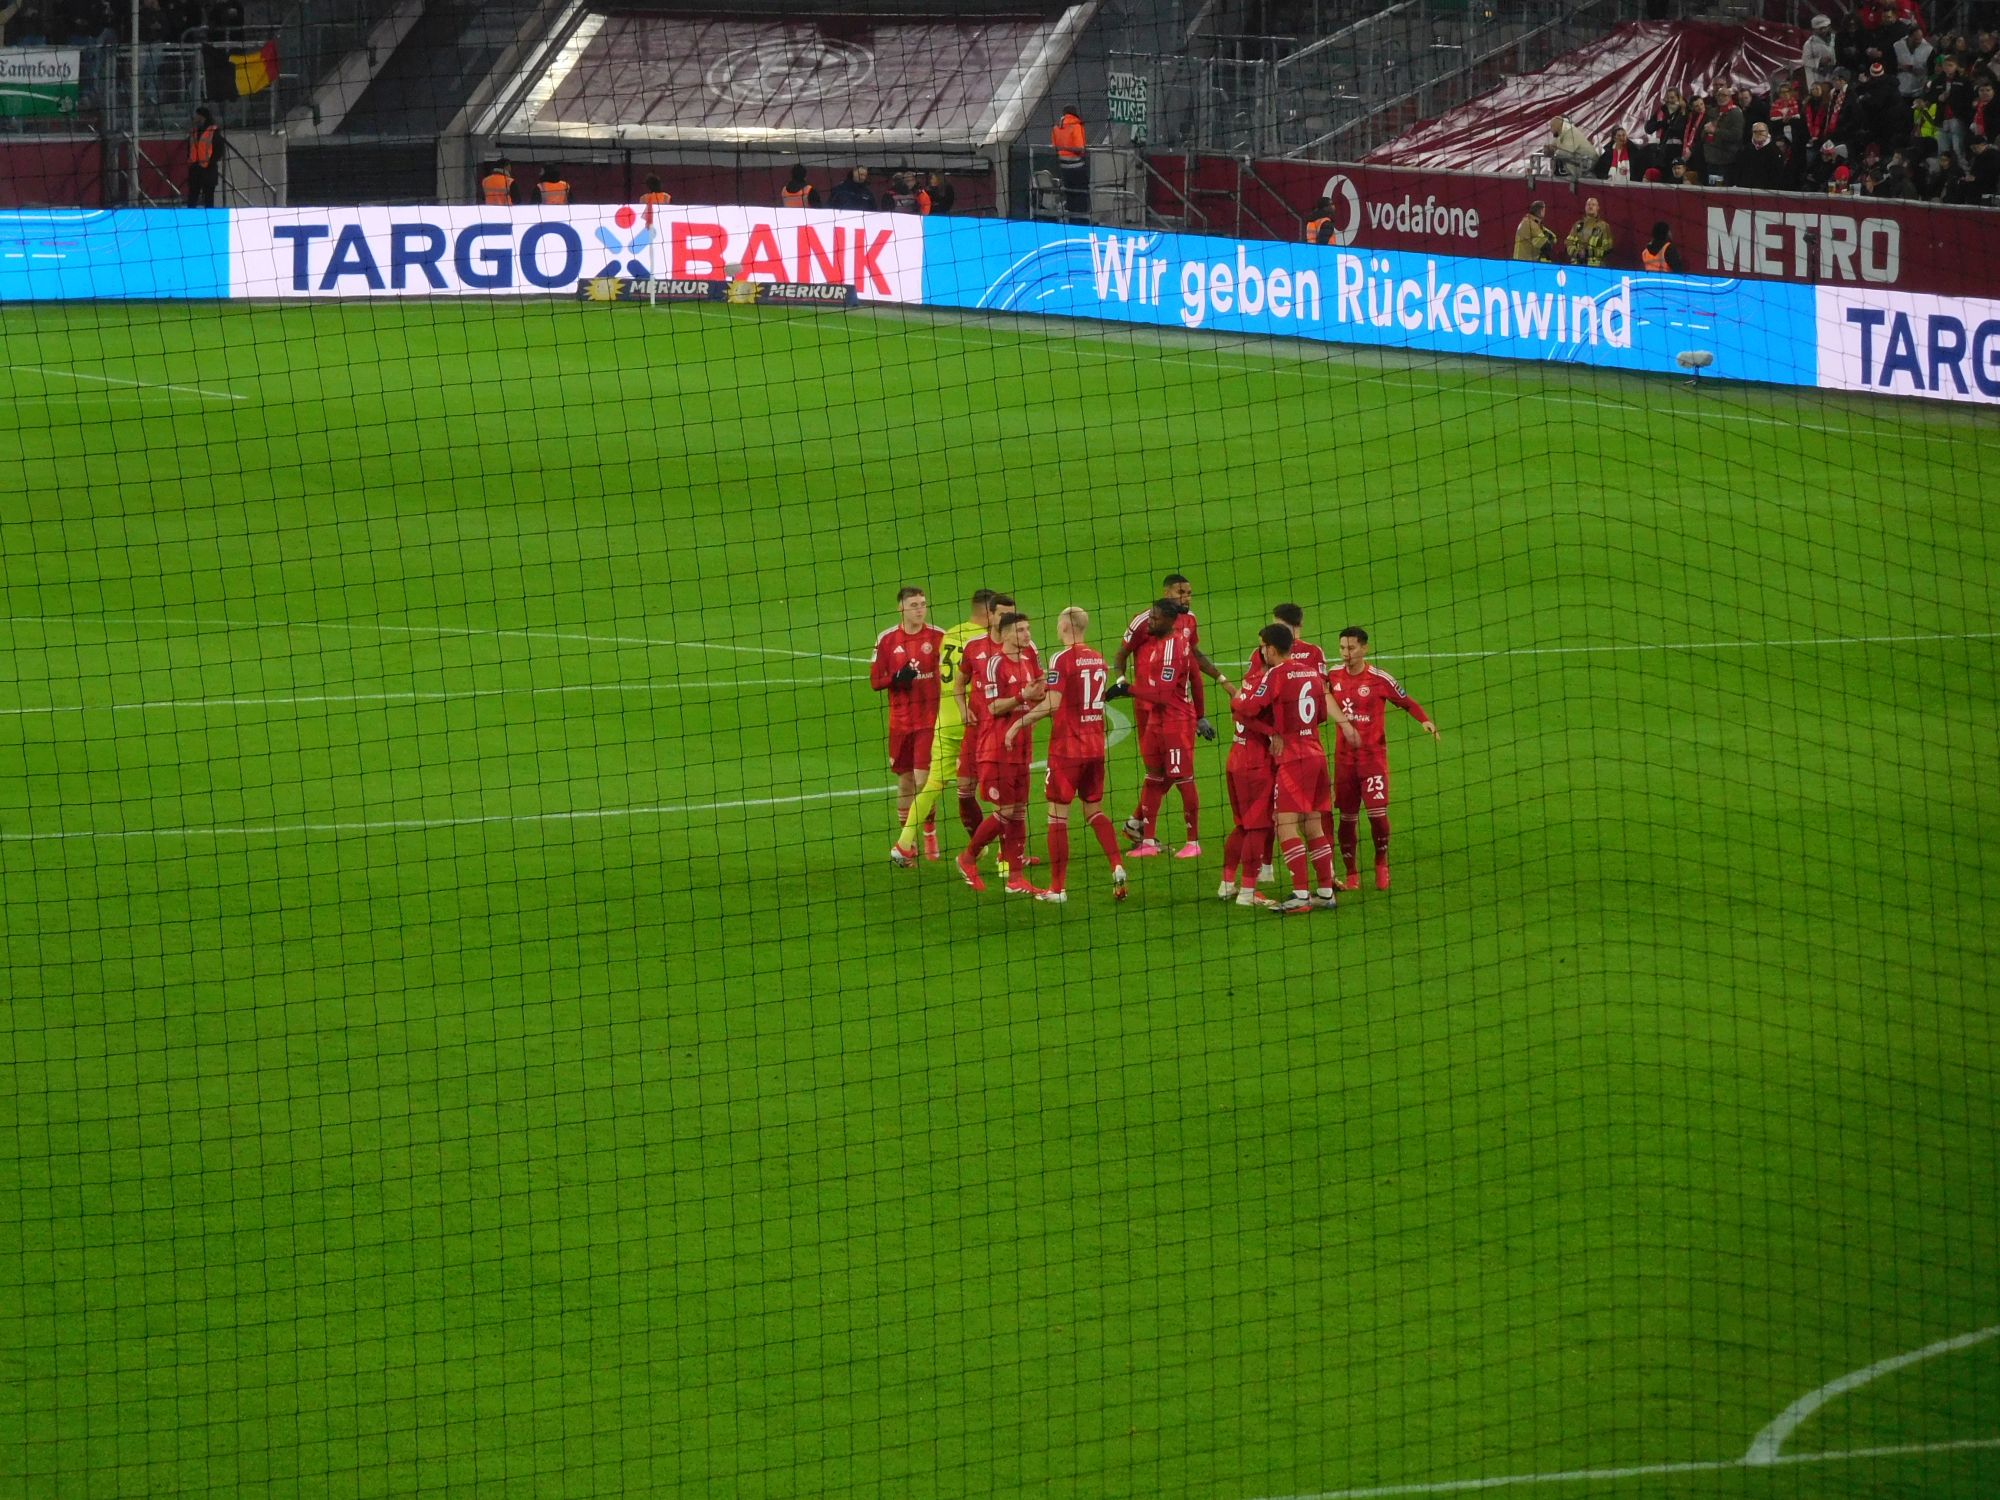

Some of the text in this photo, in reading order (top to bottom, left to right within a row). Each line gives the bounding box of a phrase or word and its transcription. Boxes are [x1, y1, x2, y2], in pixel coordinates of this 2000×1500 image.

[1366, 194, 1480, 239] vodafone
[273, 221, 894, 296] TARGO BANK
[1706, 206, 1900, 284] METRO
[629, 280, 709, 295] MERKUR
[768, 284, 848, 300] MERKUR
[1088, 232, 1631, 349] Wir geben Rückenwind
[1846, 307, 2000, 397] TARG
[1080, 668, 1107, 710] 12
[1298, 680, 1316, 724] 6
[1169, 748, 1181, 766] 11
[1366, 775, 1385, 793] 23
